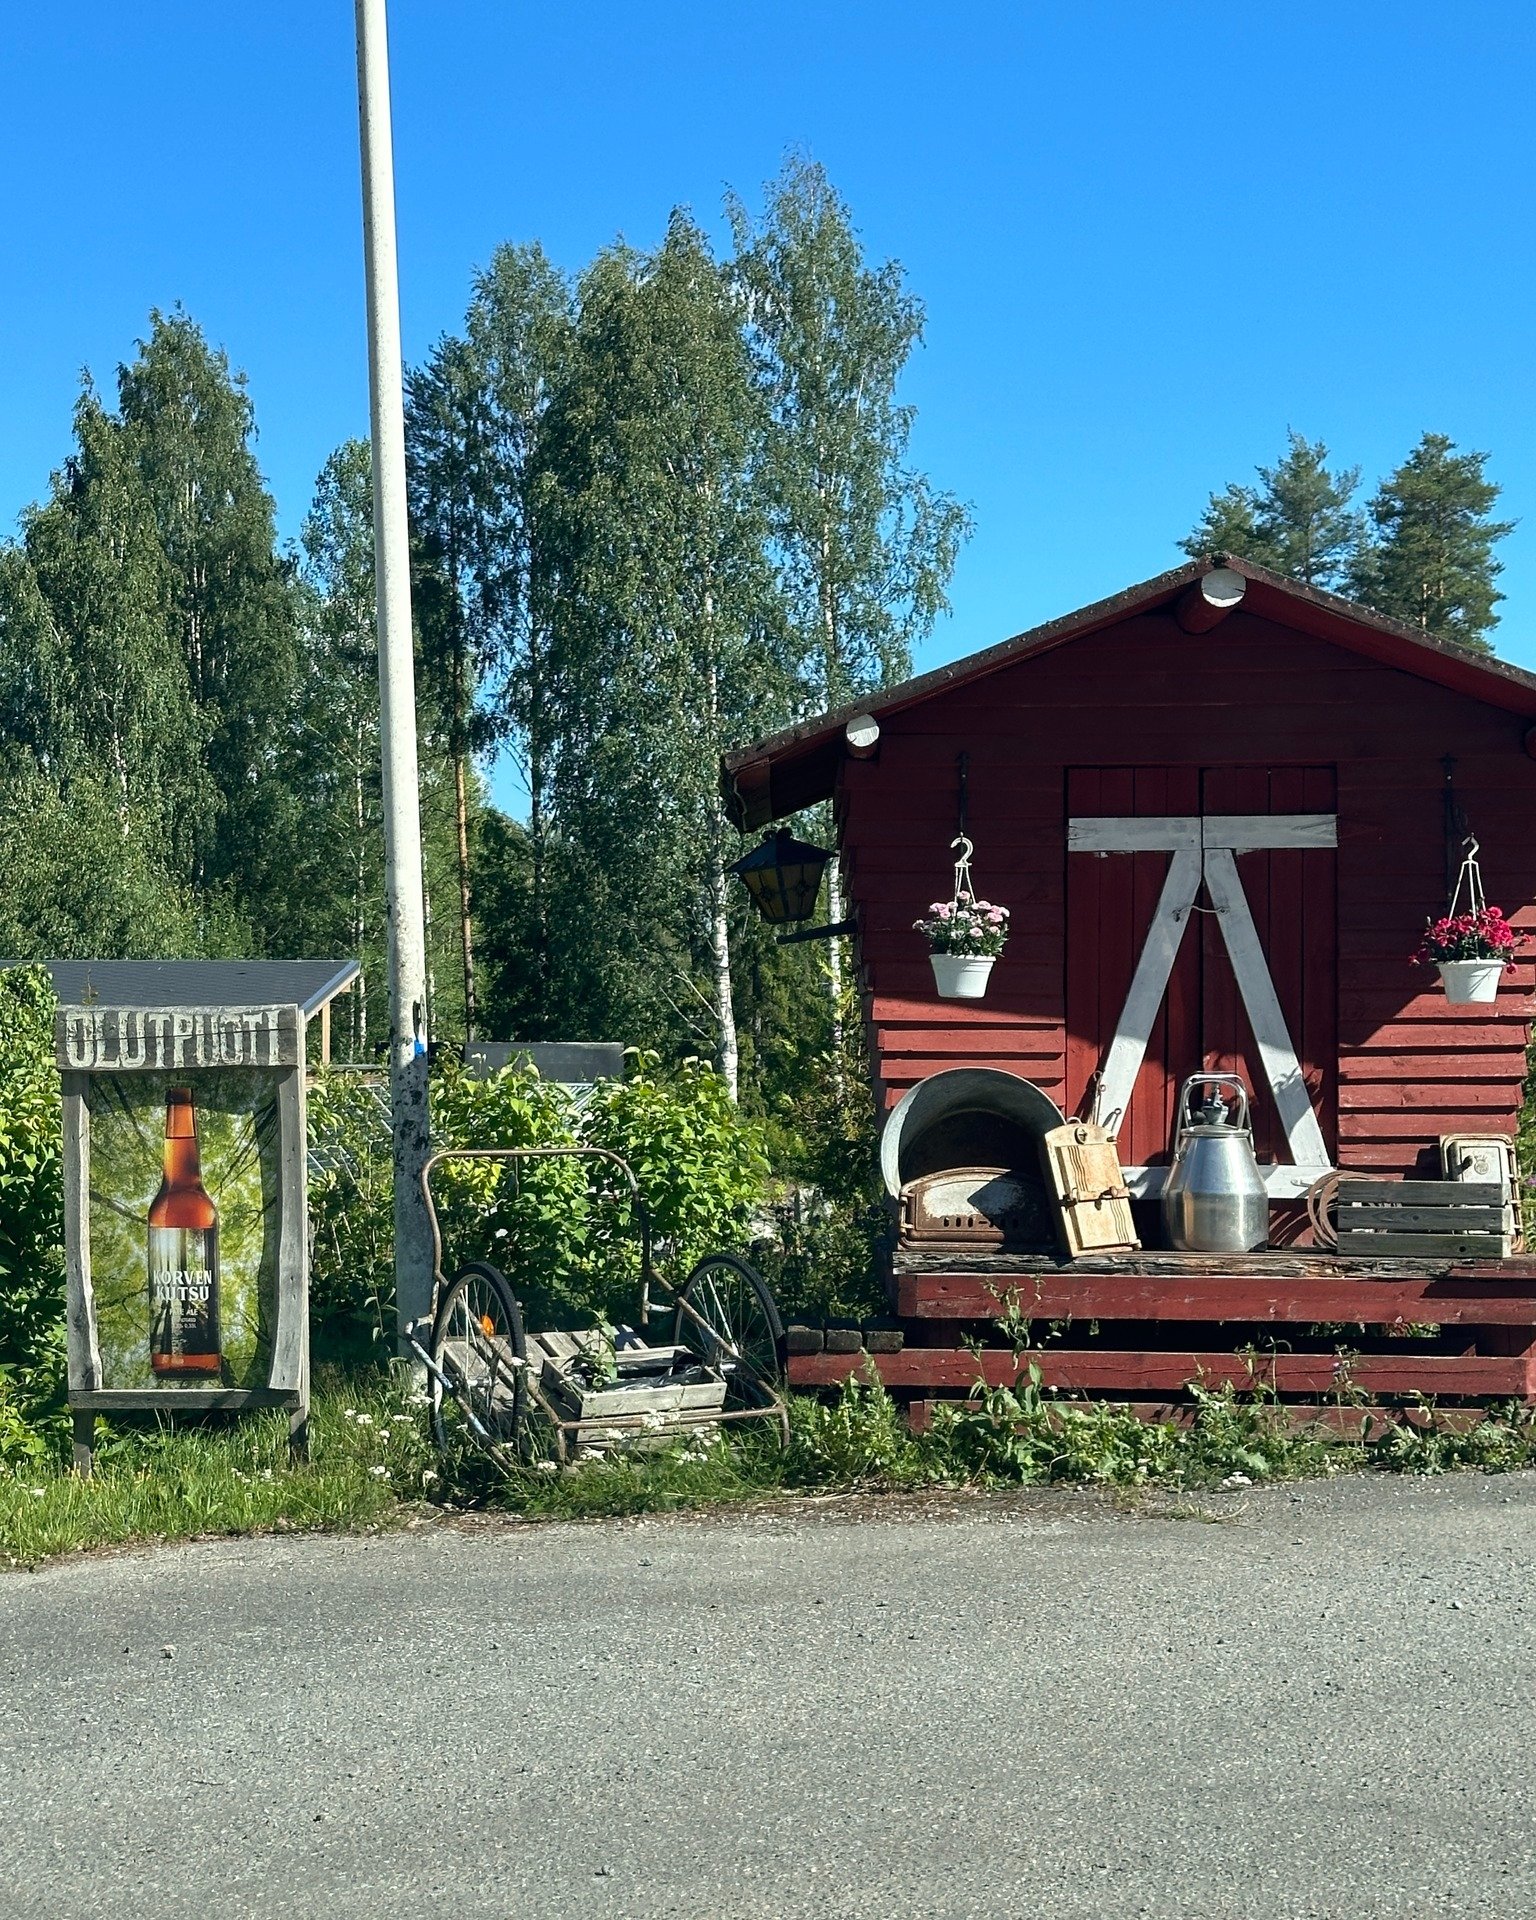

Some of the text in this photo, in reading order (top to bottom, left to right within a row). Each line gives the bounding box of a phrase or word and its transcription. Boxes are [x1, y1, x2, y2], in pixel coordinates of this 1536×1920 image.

[66, 1010, 281, 1068] OLUTPUOTI
[153, 1270, 212, 1285] KORVEN
[157, 1286, 209, 1302] KUTSU
